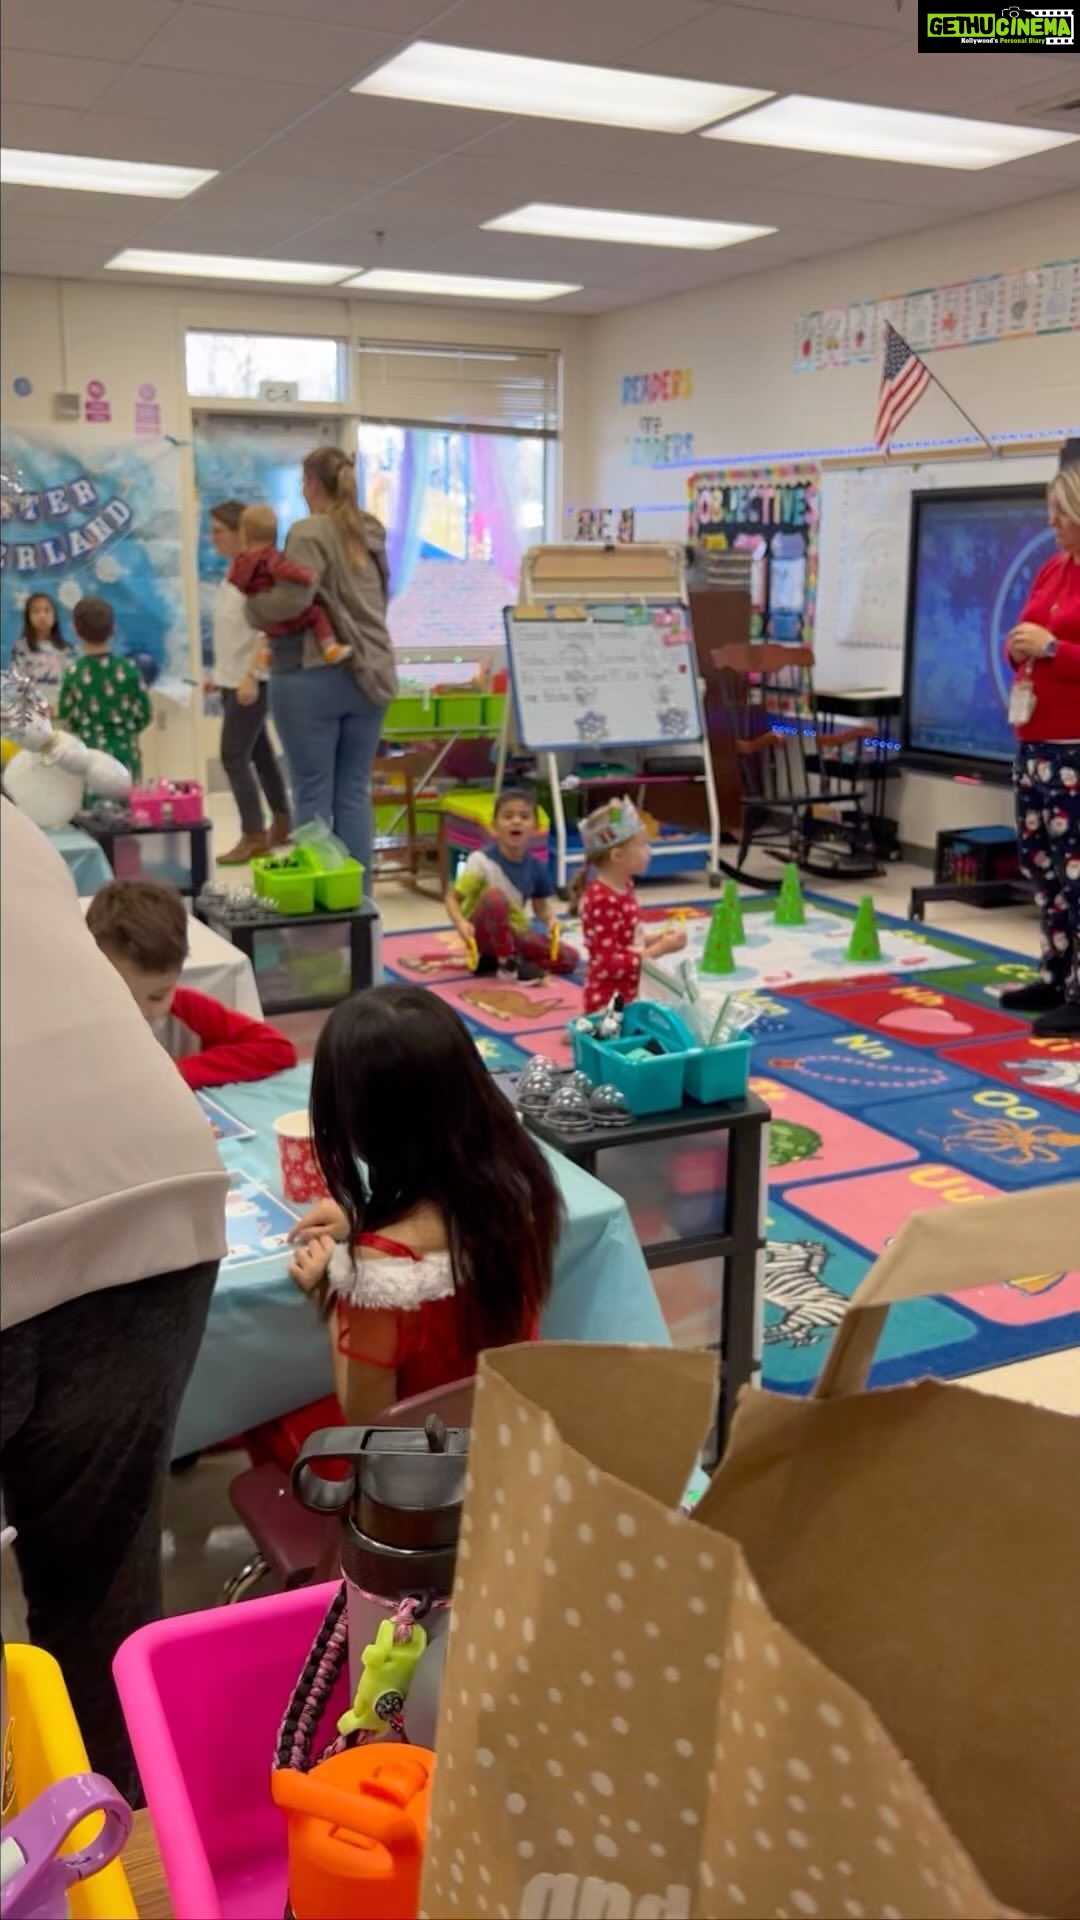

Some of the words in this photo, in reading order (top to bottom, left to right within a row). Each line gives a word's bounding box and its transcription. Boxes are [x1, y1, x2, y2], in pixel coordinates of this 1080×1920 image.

[832, 1034, 893, 1060] Nn
[972, 1090, 1040, 1120] Oo
[908, 1165, 985, 1202] Uu
